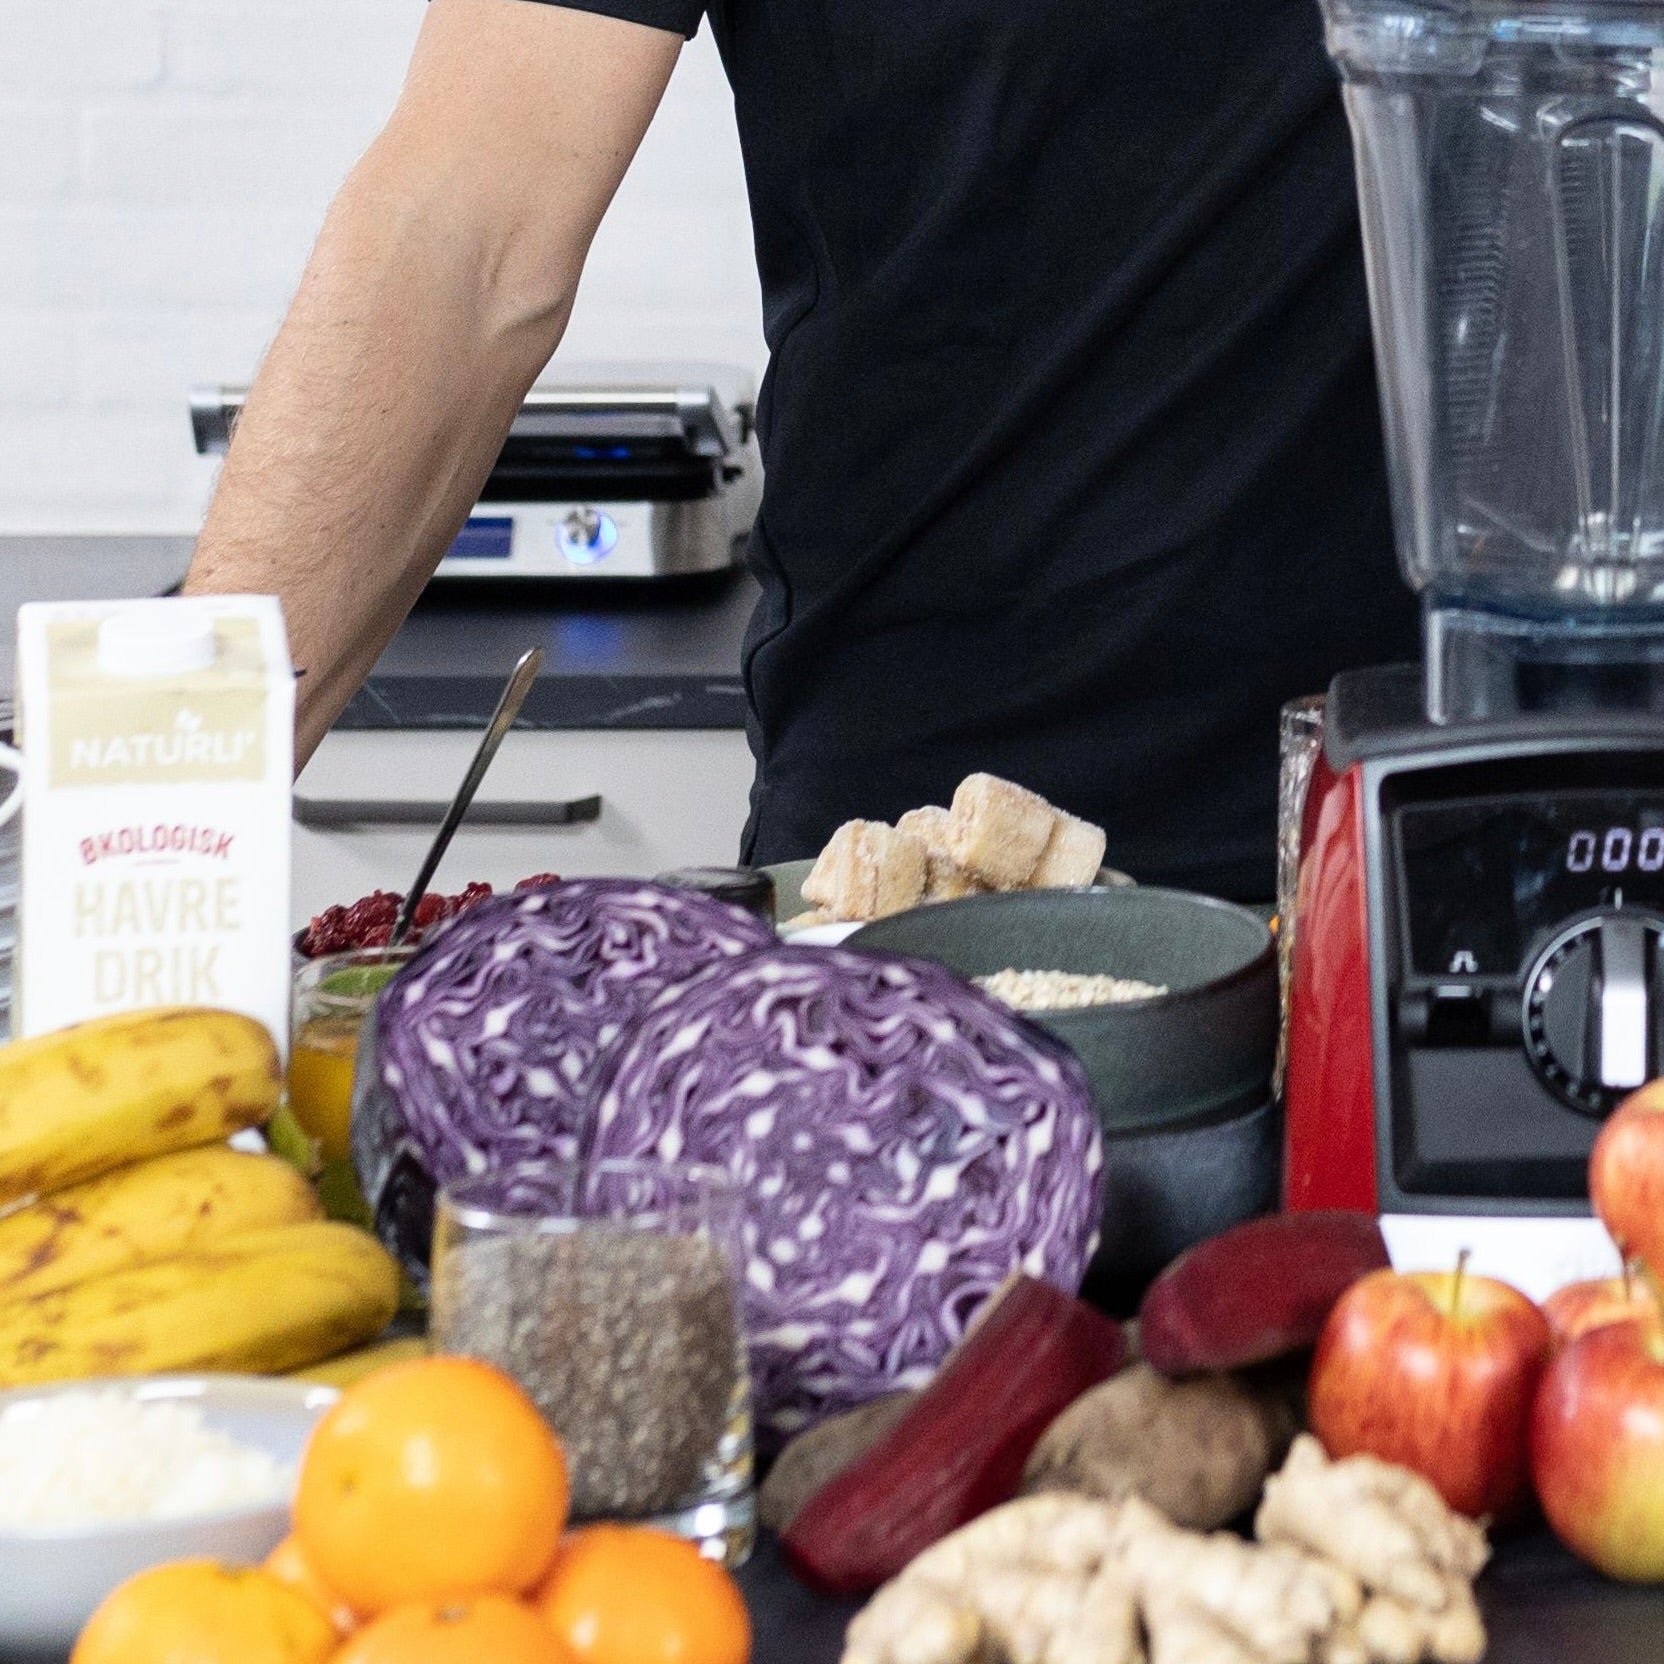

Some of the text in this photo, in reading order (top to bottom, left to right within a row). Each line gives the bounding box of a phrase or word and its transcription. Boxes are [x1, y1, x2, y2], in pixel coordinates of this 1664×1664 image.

[80, 824, 235, 866] ØKOLOGISK
[73, 876, 242, 939] HAVRE
[95, 944, 223, 1005] DRIK
